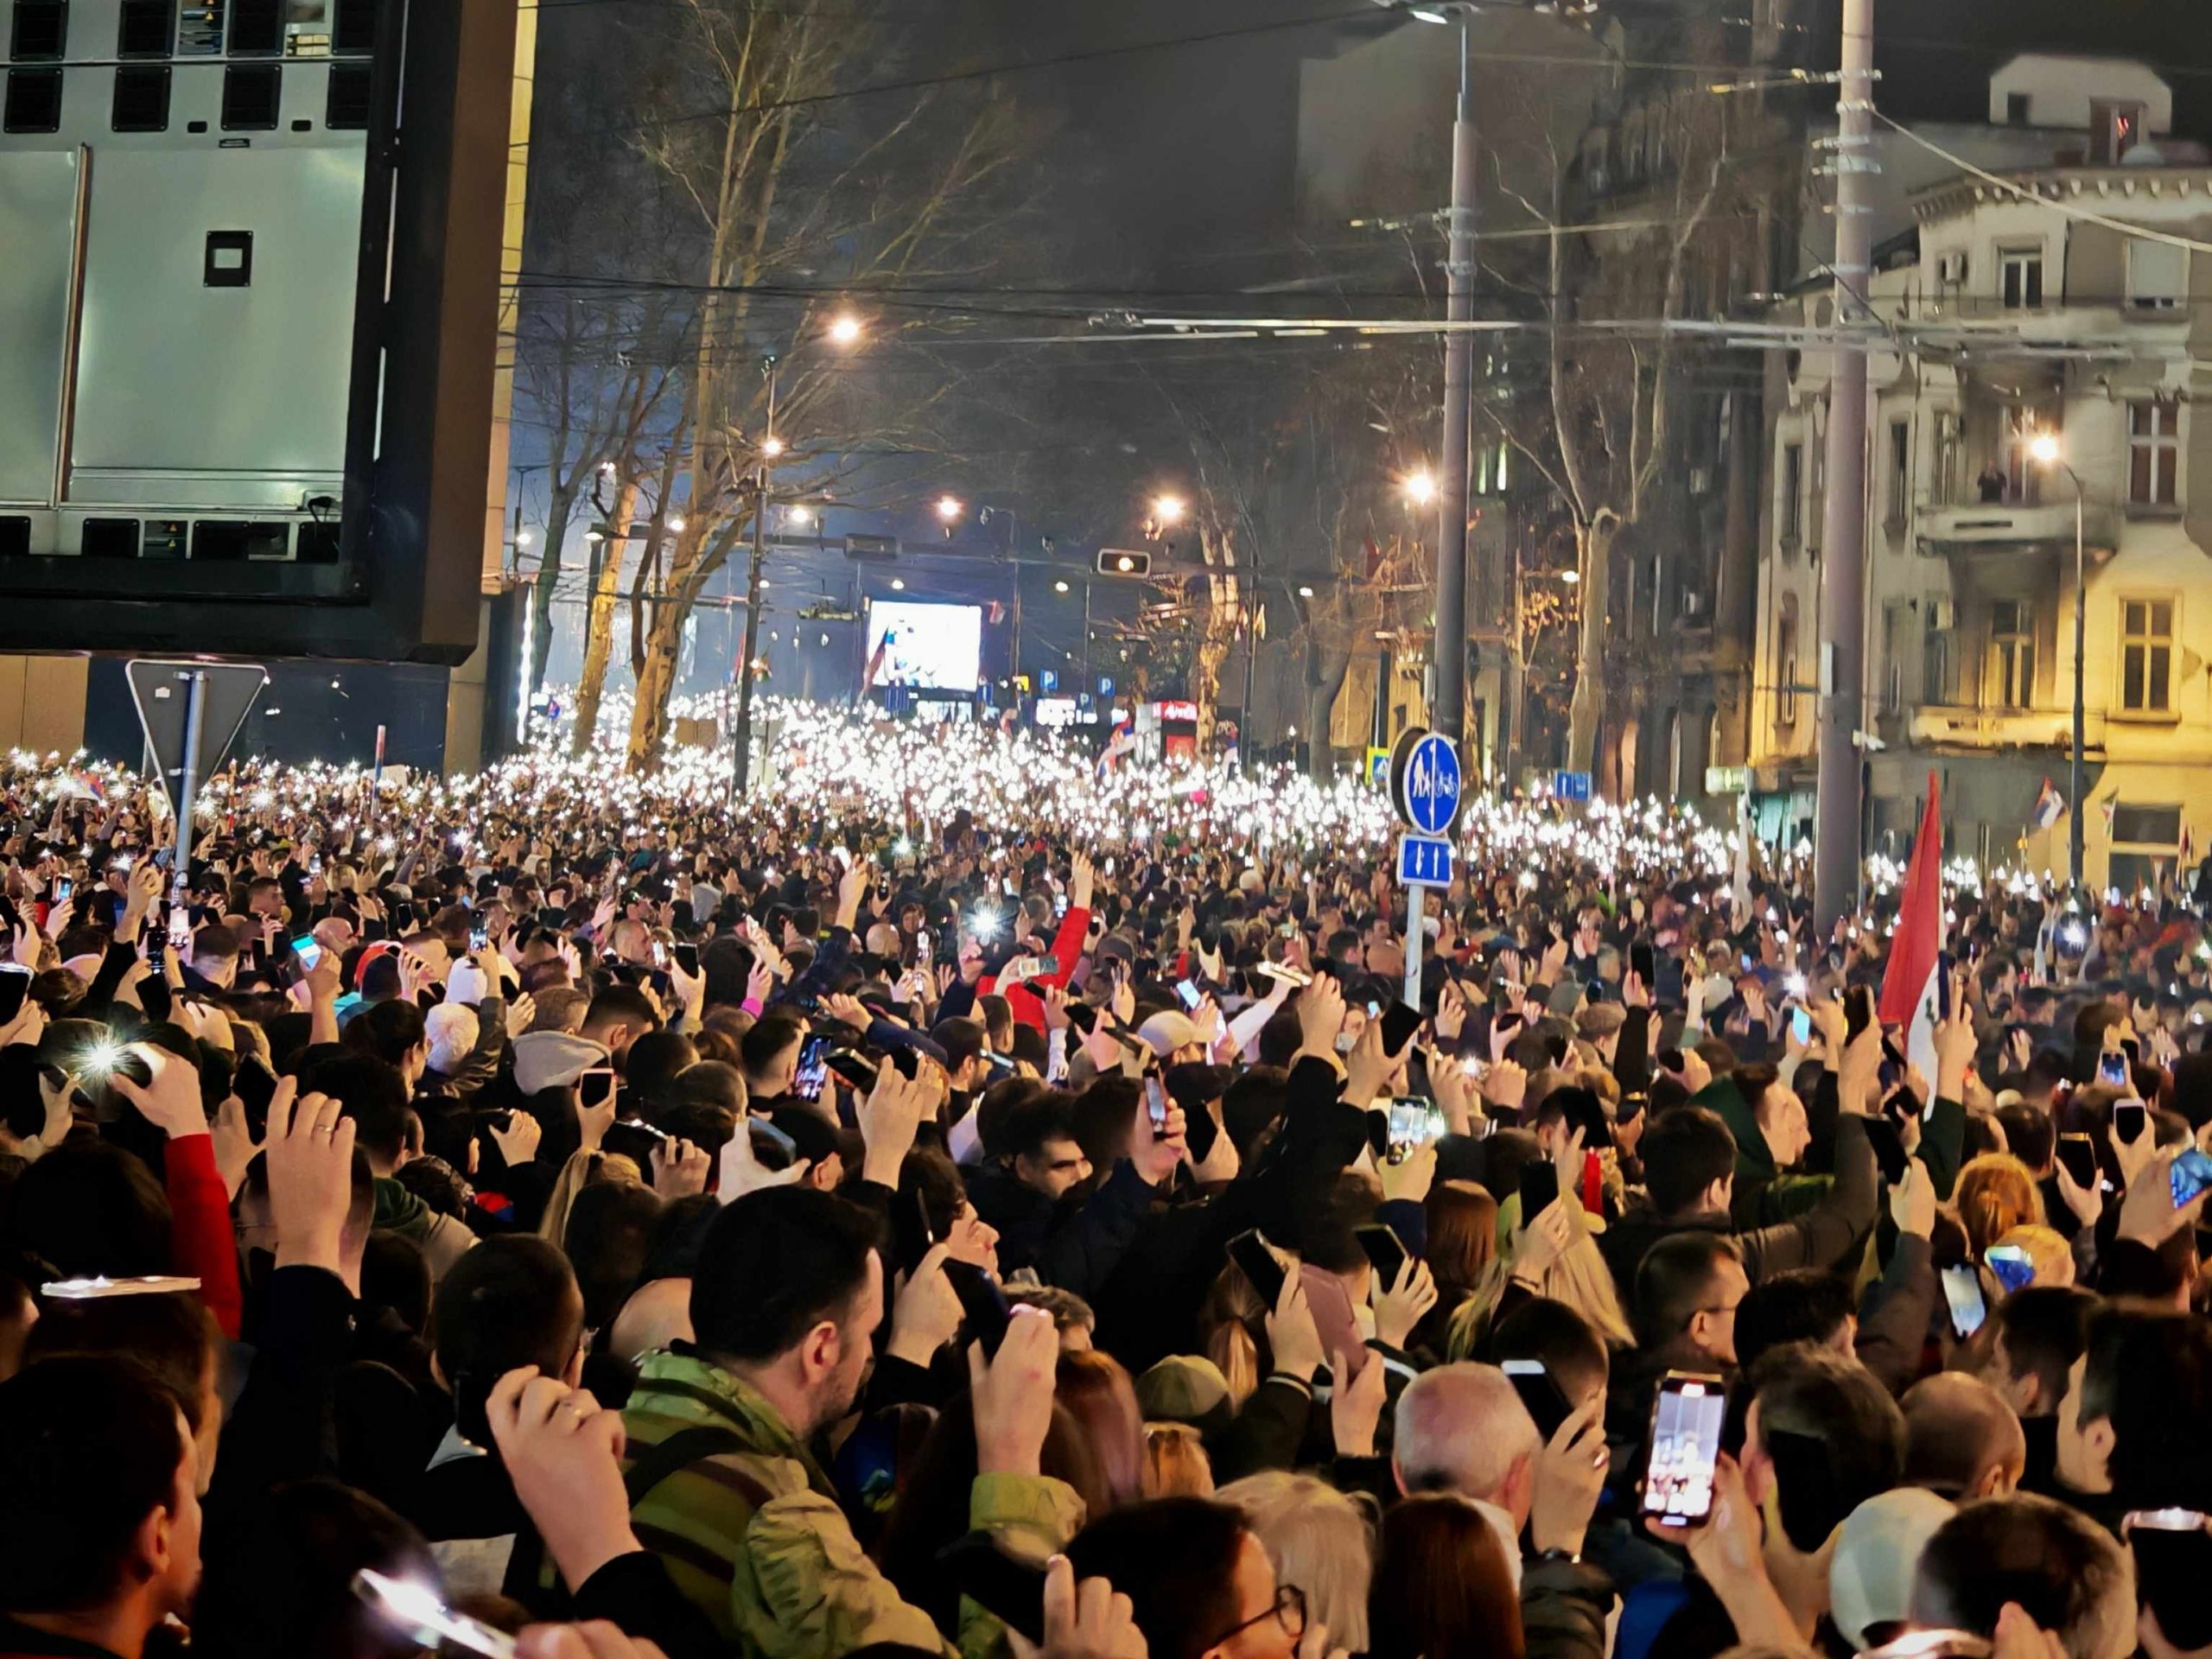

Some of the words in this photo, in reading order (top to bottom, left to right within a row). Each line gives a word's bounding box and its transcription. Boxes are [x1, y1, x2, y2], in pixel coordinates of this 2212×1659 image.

[1044, 671, 1054, 688] P
[1102, 678, 1112, 695] P
[1079, 693, 1090, 707] P
